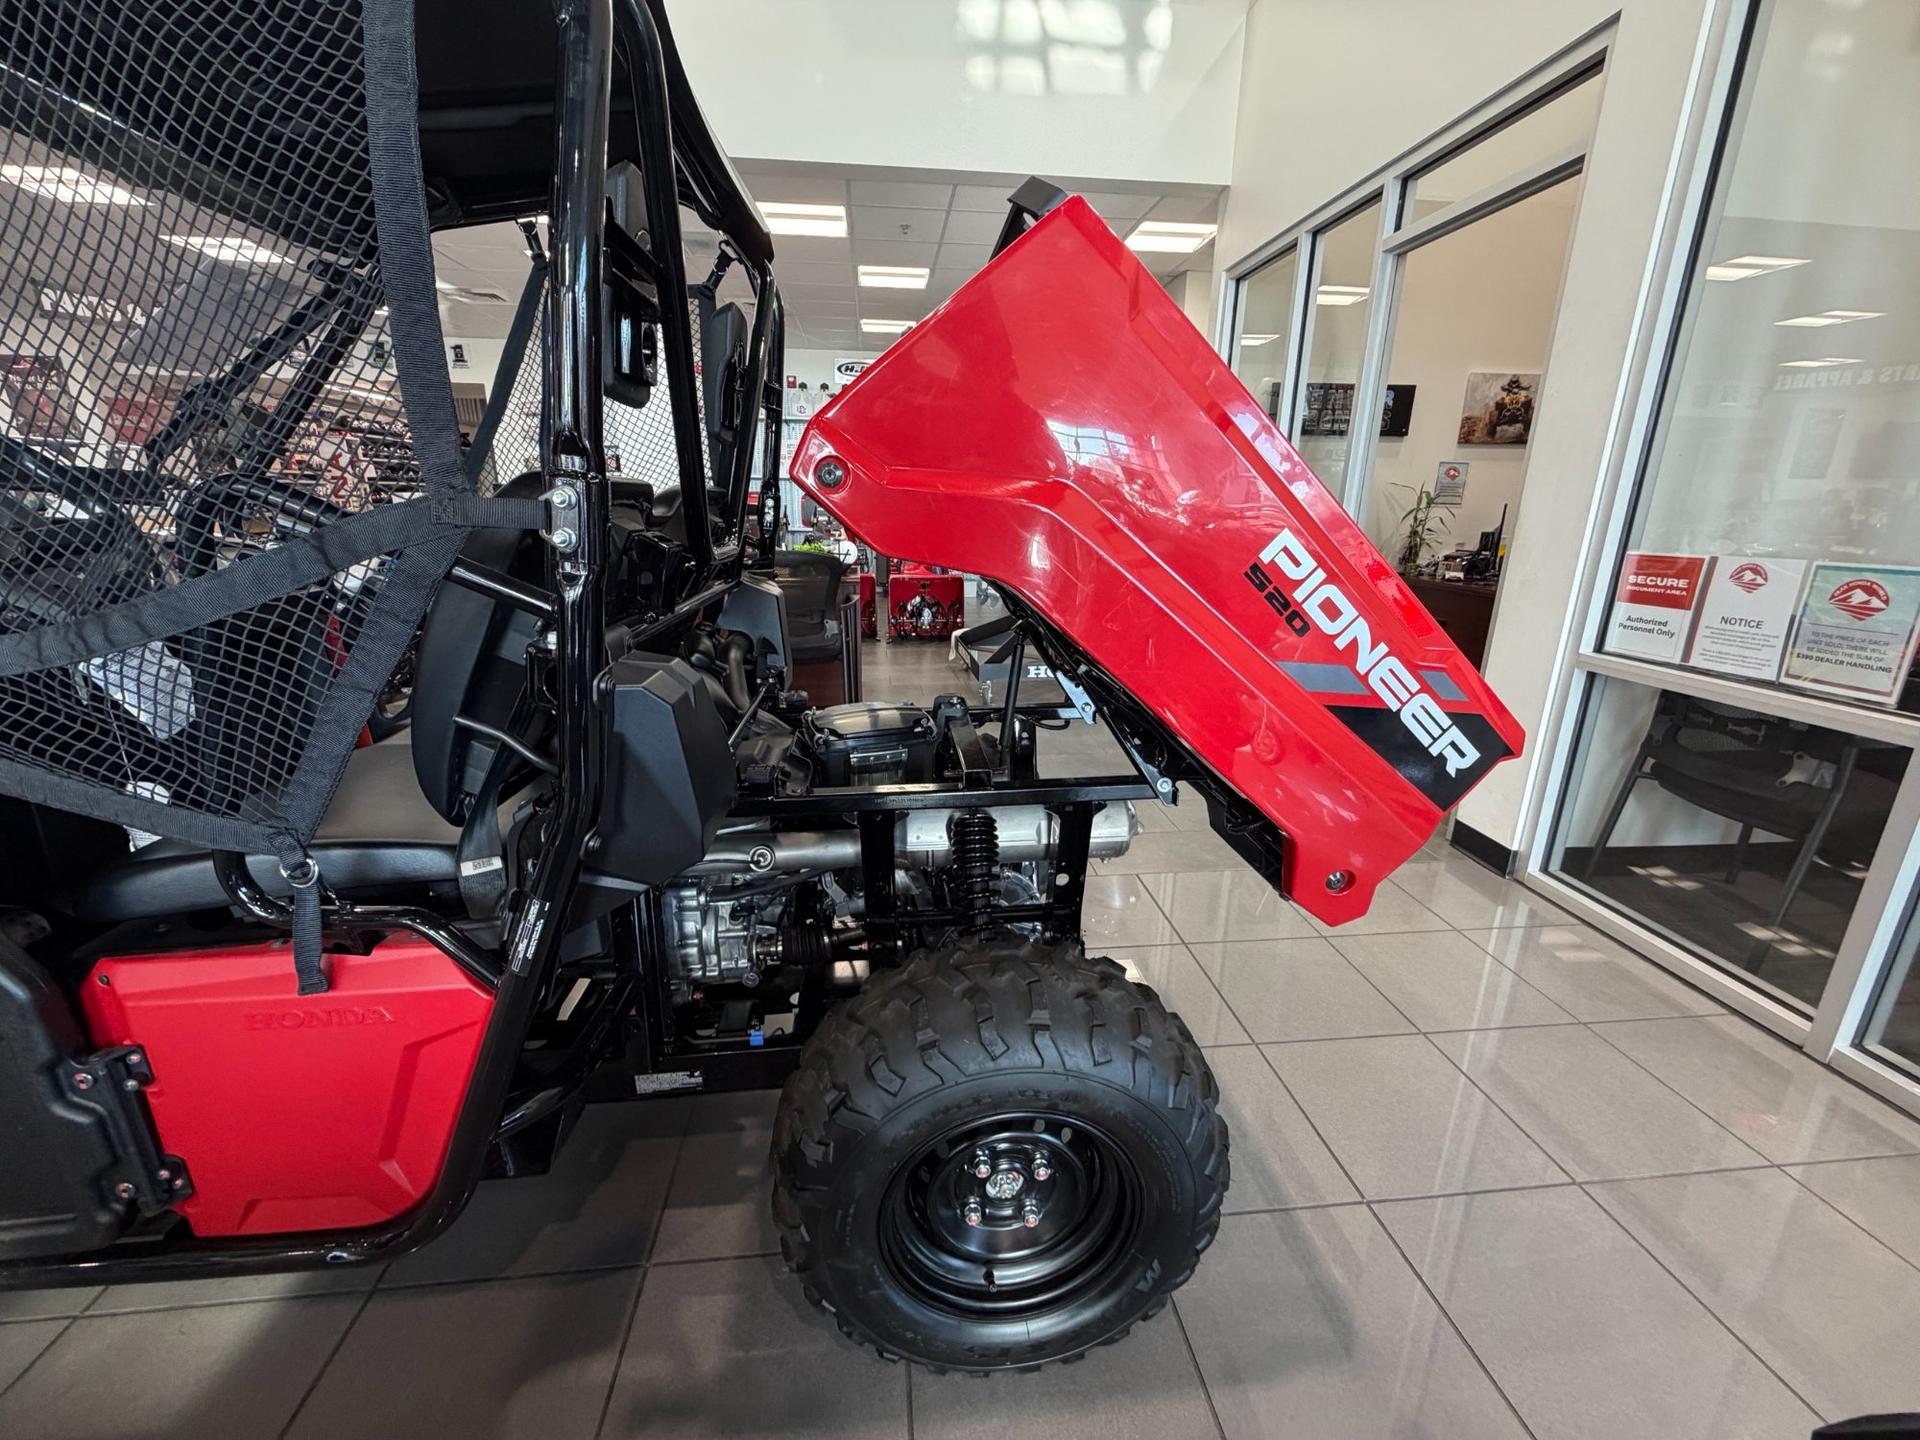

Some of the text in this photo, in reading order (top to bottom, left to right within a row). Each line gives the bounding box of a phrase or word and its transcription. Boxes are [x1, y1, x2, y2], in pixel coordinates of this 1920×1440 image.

[1626, 585, 1665, 594] DOCUMENT
[1627, 575, 1689, 588] SECURE
[1243, 562, 1310, 638] 520
[1626, 615, 1668, 627] Authorized
[1720, 615, 1764, 629] NOTICE
[1618, 622, 1675, 639] Personnel Only
[1258, 528, 1481, 778] PIONEER
[1814, 654, 1845, 666] DEALER
[1846, 660, 1893, 674] HANDLING
[246, 1006, 396, 1031] HONDA
